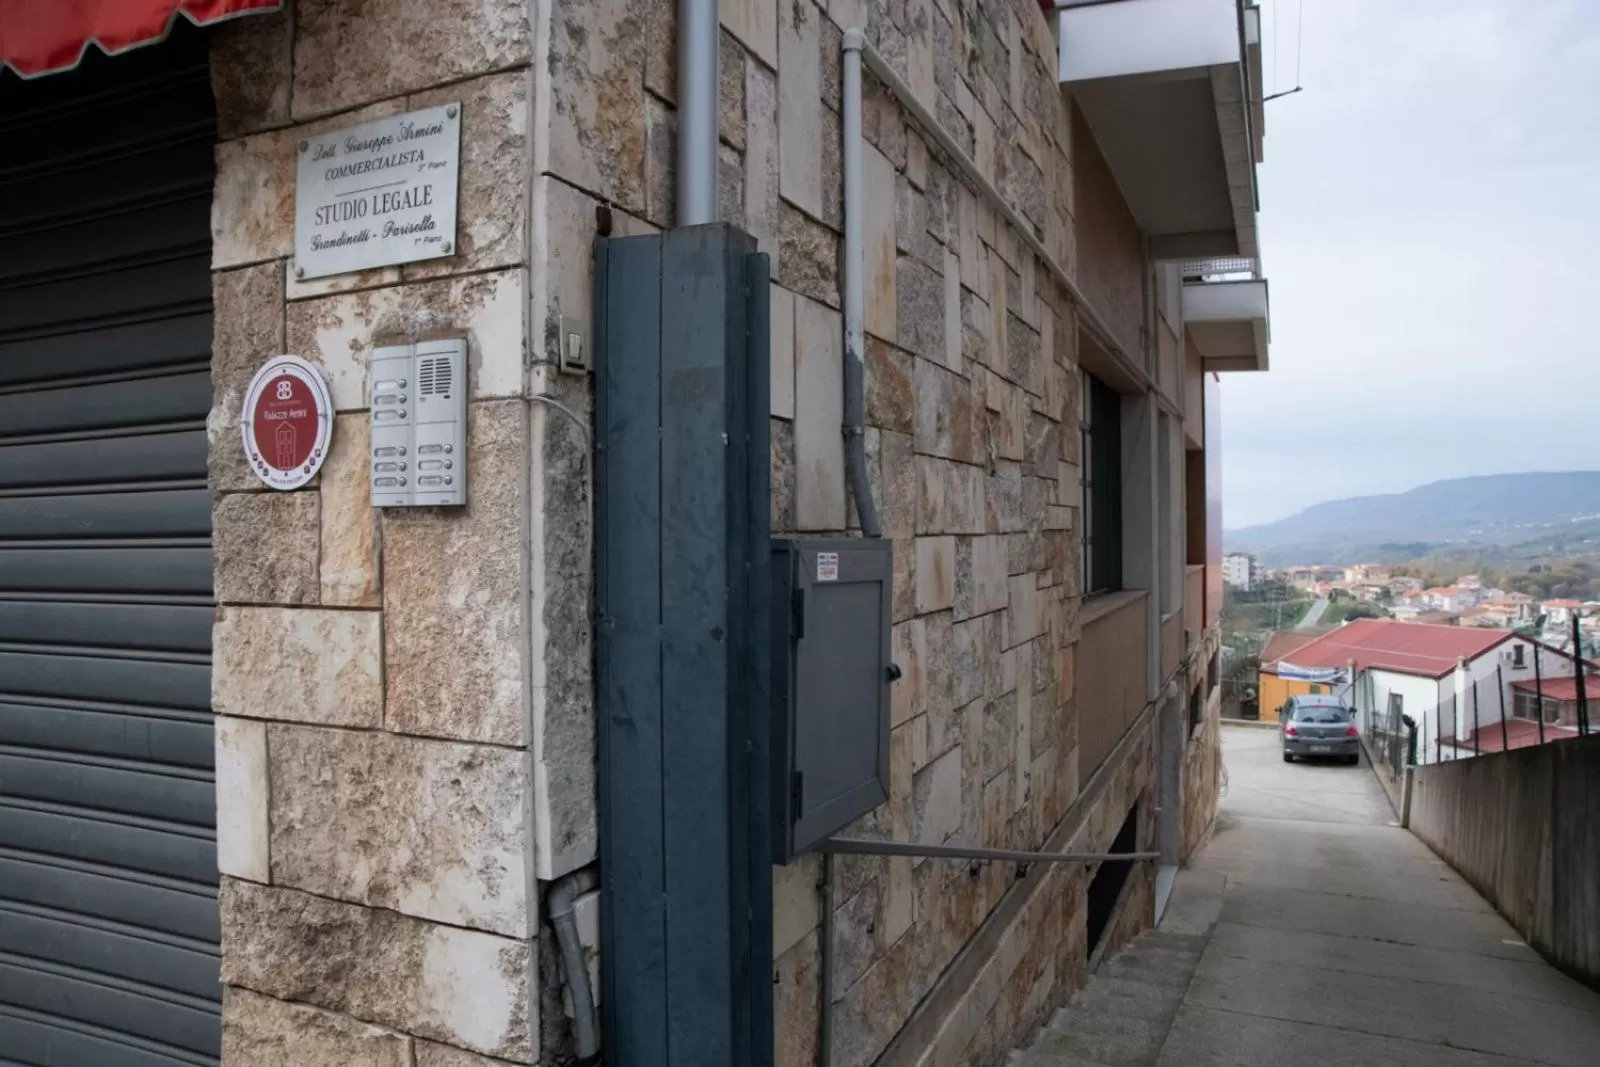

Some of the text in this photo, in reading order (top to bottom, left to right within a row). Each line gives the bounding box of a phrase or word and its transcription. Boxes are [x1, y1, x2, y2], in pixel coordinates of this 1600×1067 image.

[344, 135, 393, 155] Giuseppe
[397, 121, 444, 142] Armini
[325, 149, 424, 180] COMMERCIALISTA
[315, 184, 433, 226] STUDIO LEGALE
[381, 214, 436, 239] Parisella
